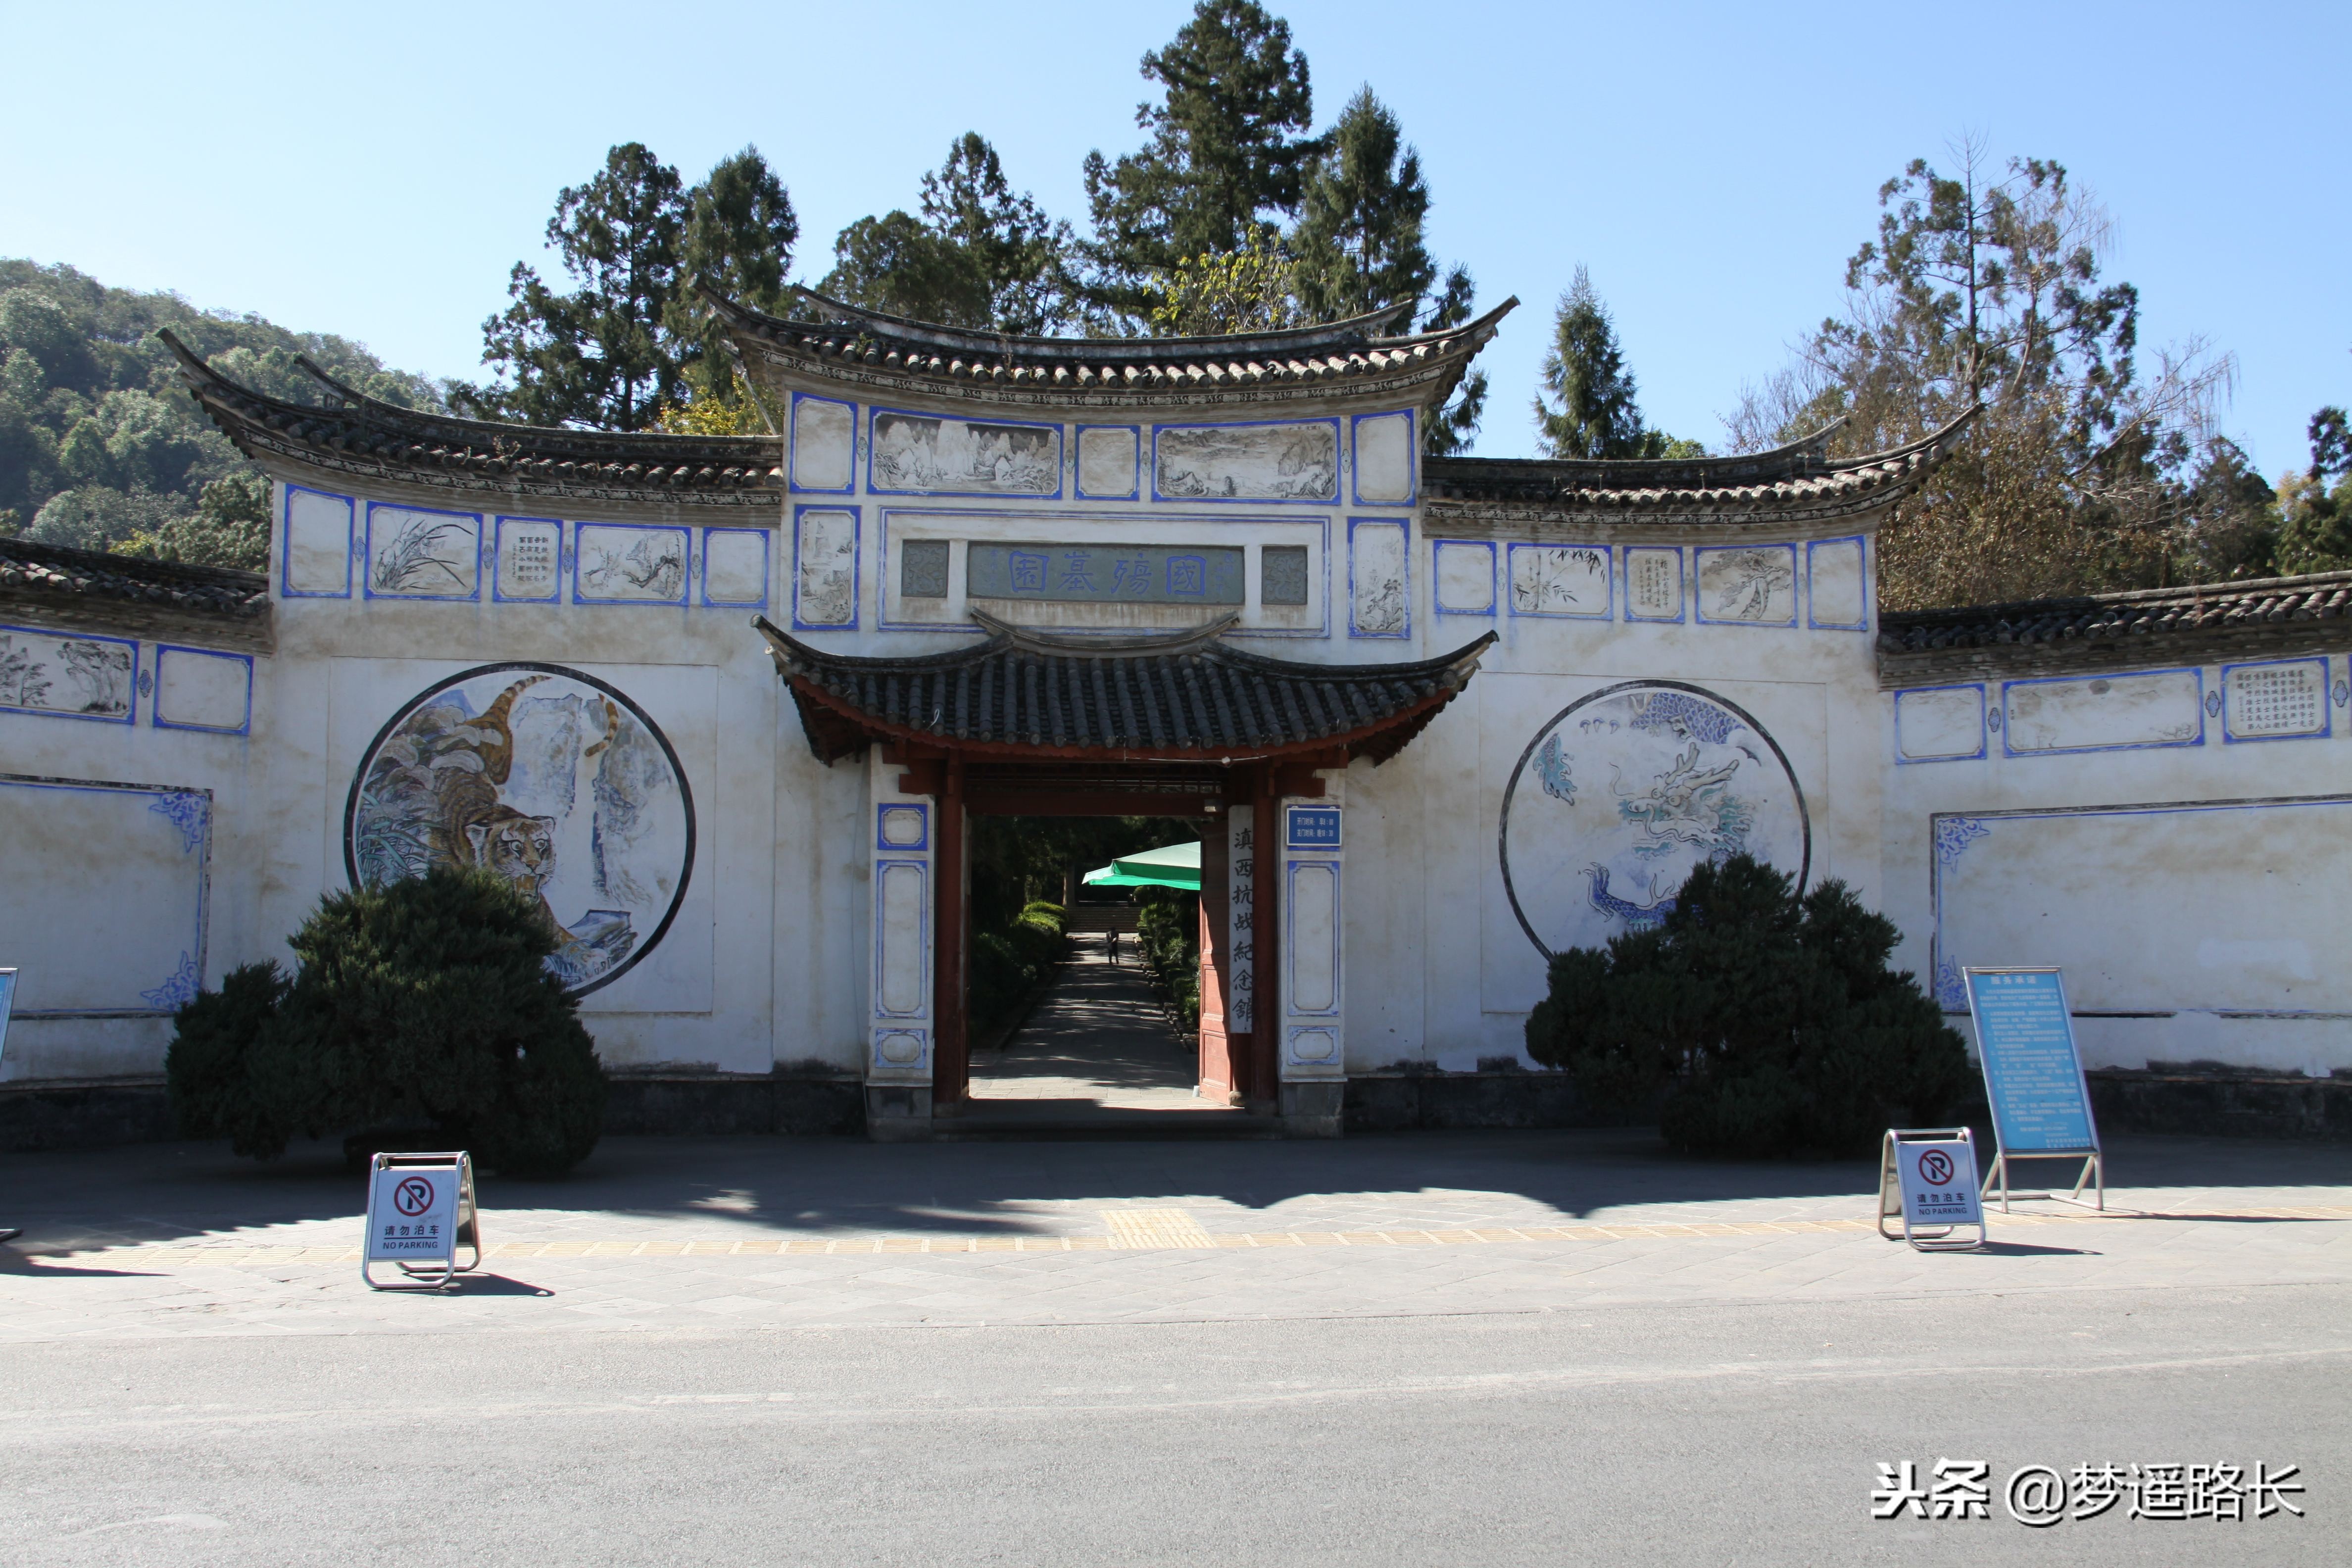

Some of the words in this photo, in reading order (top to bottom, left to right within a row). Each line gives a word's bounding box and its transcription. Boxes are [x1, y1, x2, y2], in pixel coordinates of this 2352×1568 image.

[1009, 550, 1207, 596] 國殤墓園
[1916, 1193, 1965, 1203] 请勿泊车
[385, 1225, 439, 1236] 请勿泊车
